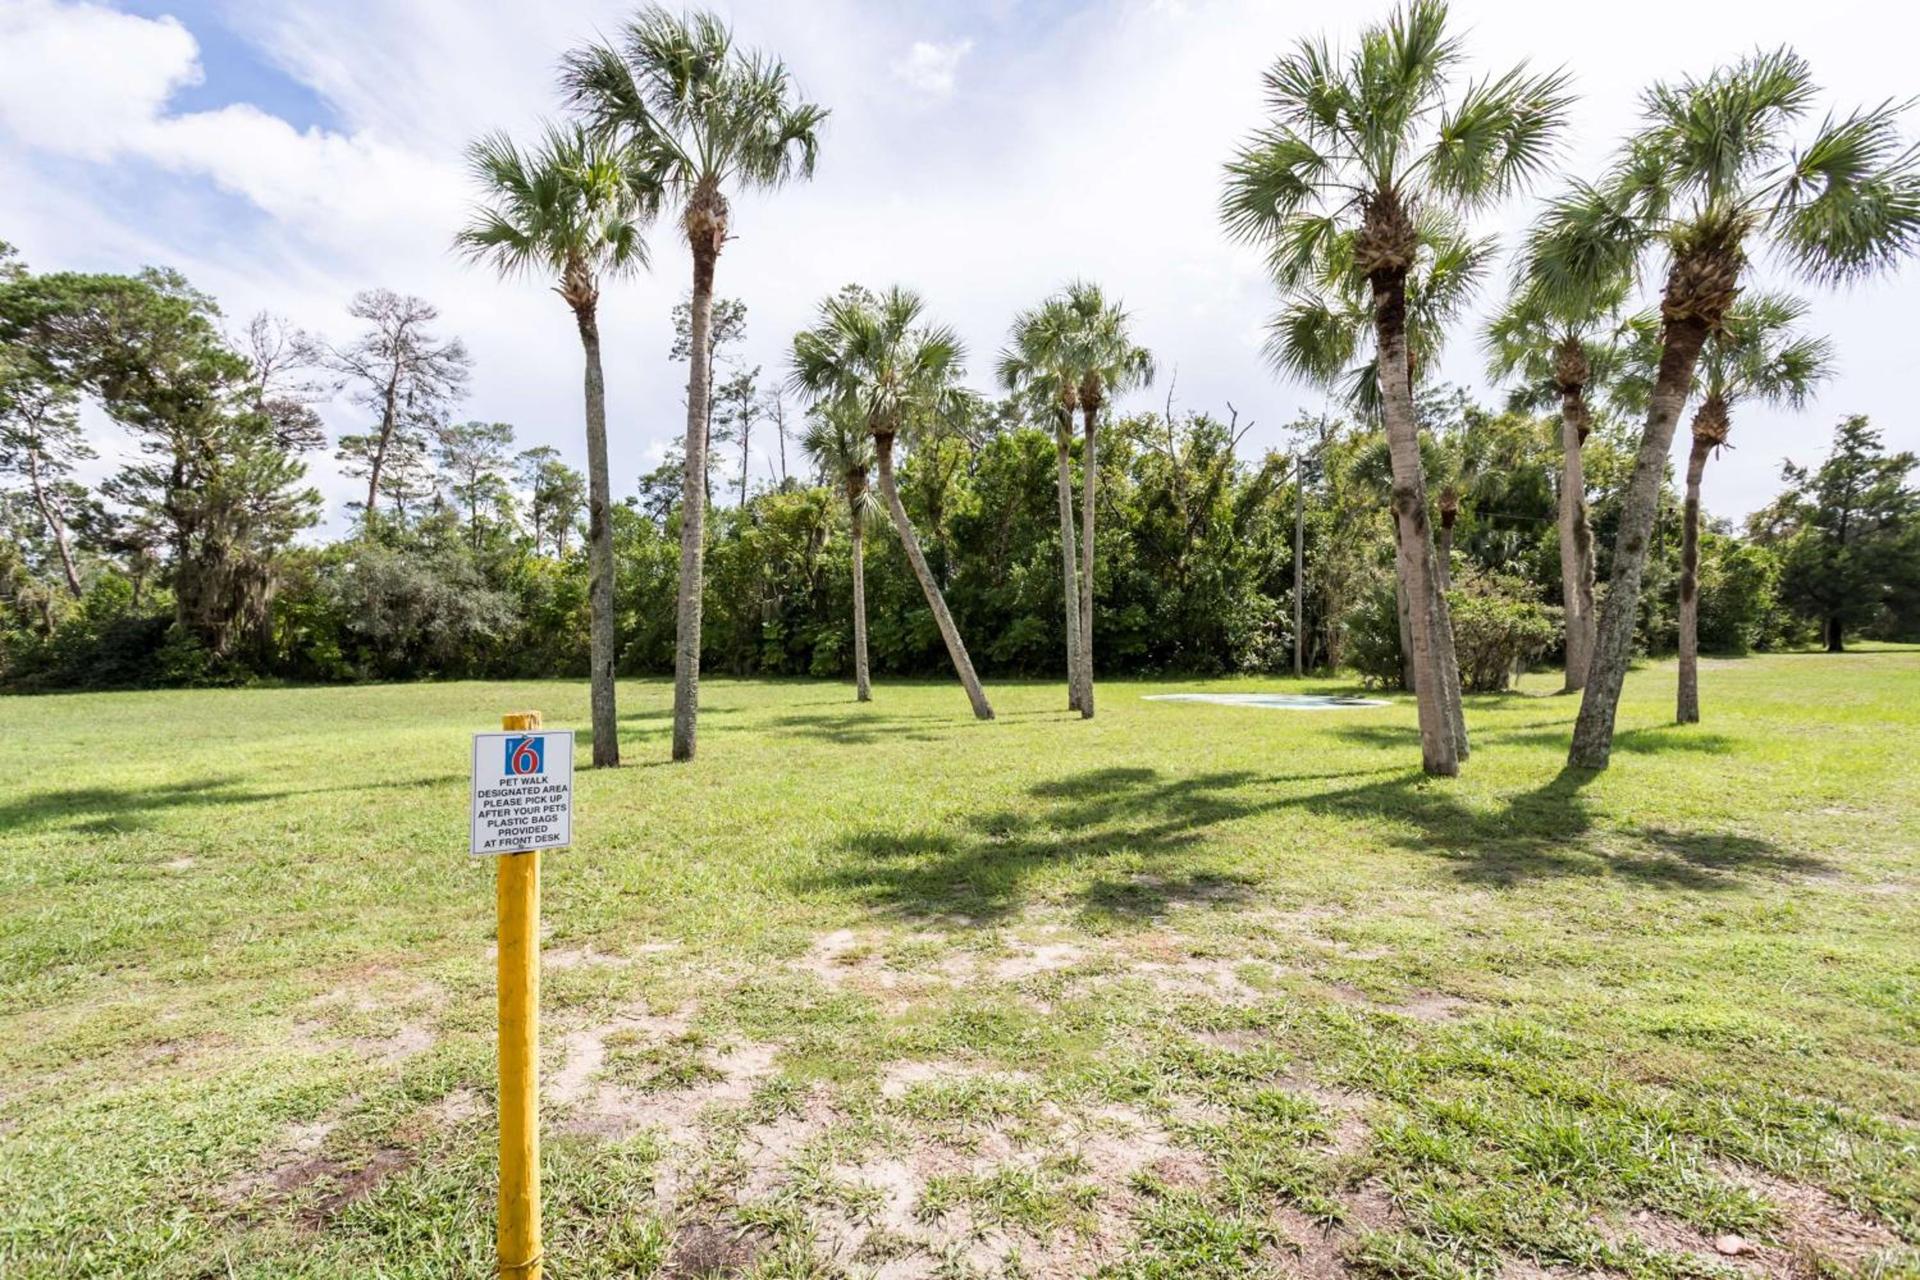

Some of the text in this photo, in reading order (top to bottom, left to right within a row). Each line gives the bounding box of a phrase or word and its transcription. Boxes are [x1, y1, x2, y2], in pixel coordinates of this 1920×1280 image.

[512, 738, 539, 775] 6
[478, 785, 567, 798] DESIGNATED AREA
[484, 799, 522, 808] PLEASE
[478, 804, 566, 818] AFTER YOUR PETS
[488, 815, 557, 827] PLASTIC BAGS
[498, 826, 548, 836] PROVIDED
[500, 837, 532, 846] FRONT
[535, 834, 560, 842] DESK
